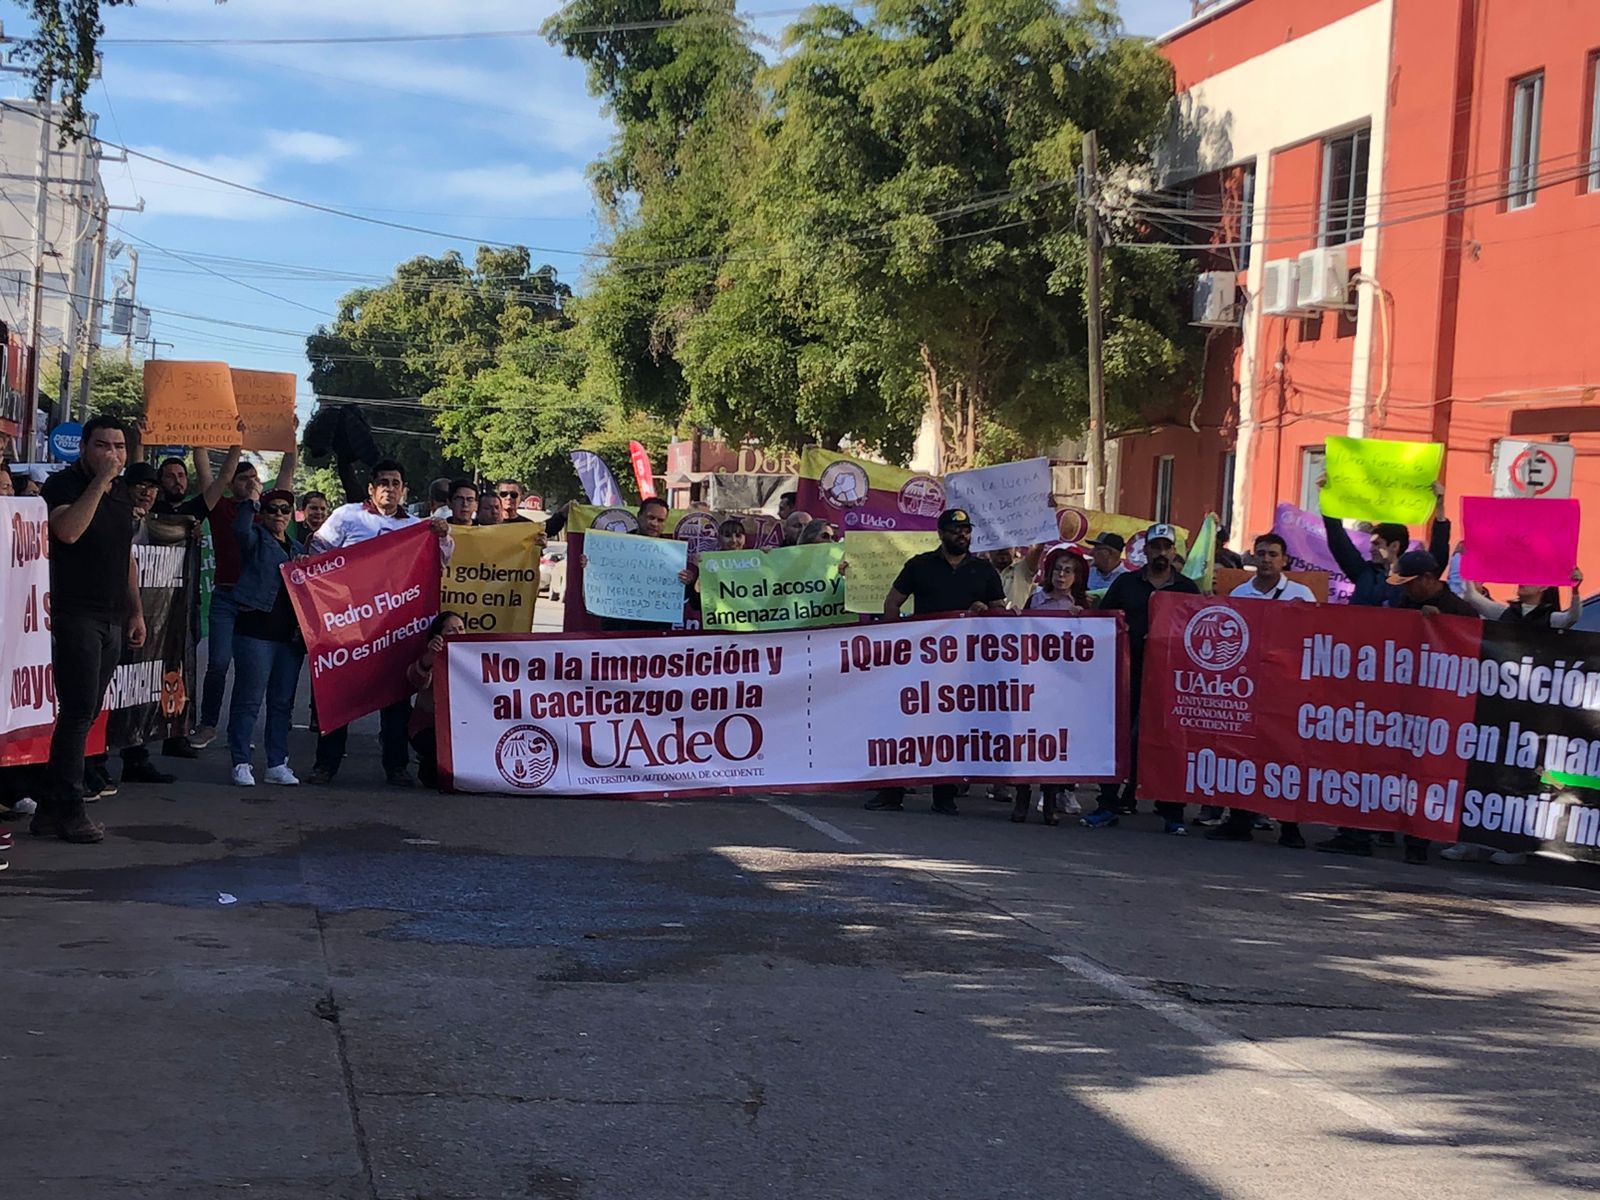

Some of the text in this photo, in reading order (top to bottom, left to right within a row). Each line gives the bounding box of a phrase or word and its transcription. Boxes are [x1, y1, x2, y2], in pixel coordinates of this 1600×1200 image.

[306, 555, 345, 578] UAdeO
[455, 562, 535, 583] gobierno
[600, 556, 667, 570] DESIGNAR
[481, 591, 506, 607] en
[508, 588, 522, 607] la
[719, 578, 841, 599] No al acoso y
[322, 583, 421, 633] Pedro Flores
[706, 607, 790, 625] amenaza
[313, 647, 350, 679] ¡NO
[351, 643, 370, 662] es
[371, 629, 391, 654] mi
[481, 644, 783, 684] No a la imposición y
[839, 631, 1094, 673] ¡Que se respete
[1300, 633, 1350, 681] ¡No
[1357, 644, 1377, 682] a
[1384, 639, 1414, 685] la
[900, 678, 1035, 715] el sentir
[1173, 670, 1254, 698] UAdeO
[493, 681, 763, 720] al cacicazgo en la
[1177, 694, 1248, 711] UNIVERSIDAD
[1180, 716, 1242, 732] OCCIDENTE
[1236, 712, 1252, 722] DE
[575, 713, 764, 769] UAdeO
[867, 728, 1068, 767] mayoritario!
[1298, 700, 1449, 758] cacicazgo
[1456, 721, 1500, 764] en
[1504, 721, 1540, 769] la
[578, 776, 640, 785] UNIVERSIDAD
[698, 771, 711, 779] DE
[712, 768, 765, 778] OCCIDENTE
[1185, 748, 1256, 797] ¡Que
[1263, 762, 1300, 800] se
[1307, 767, 1418, 817] respete
[1423, 779, 1459, 823] el
[1462, 789, 1565, 841] sentir
